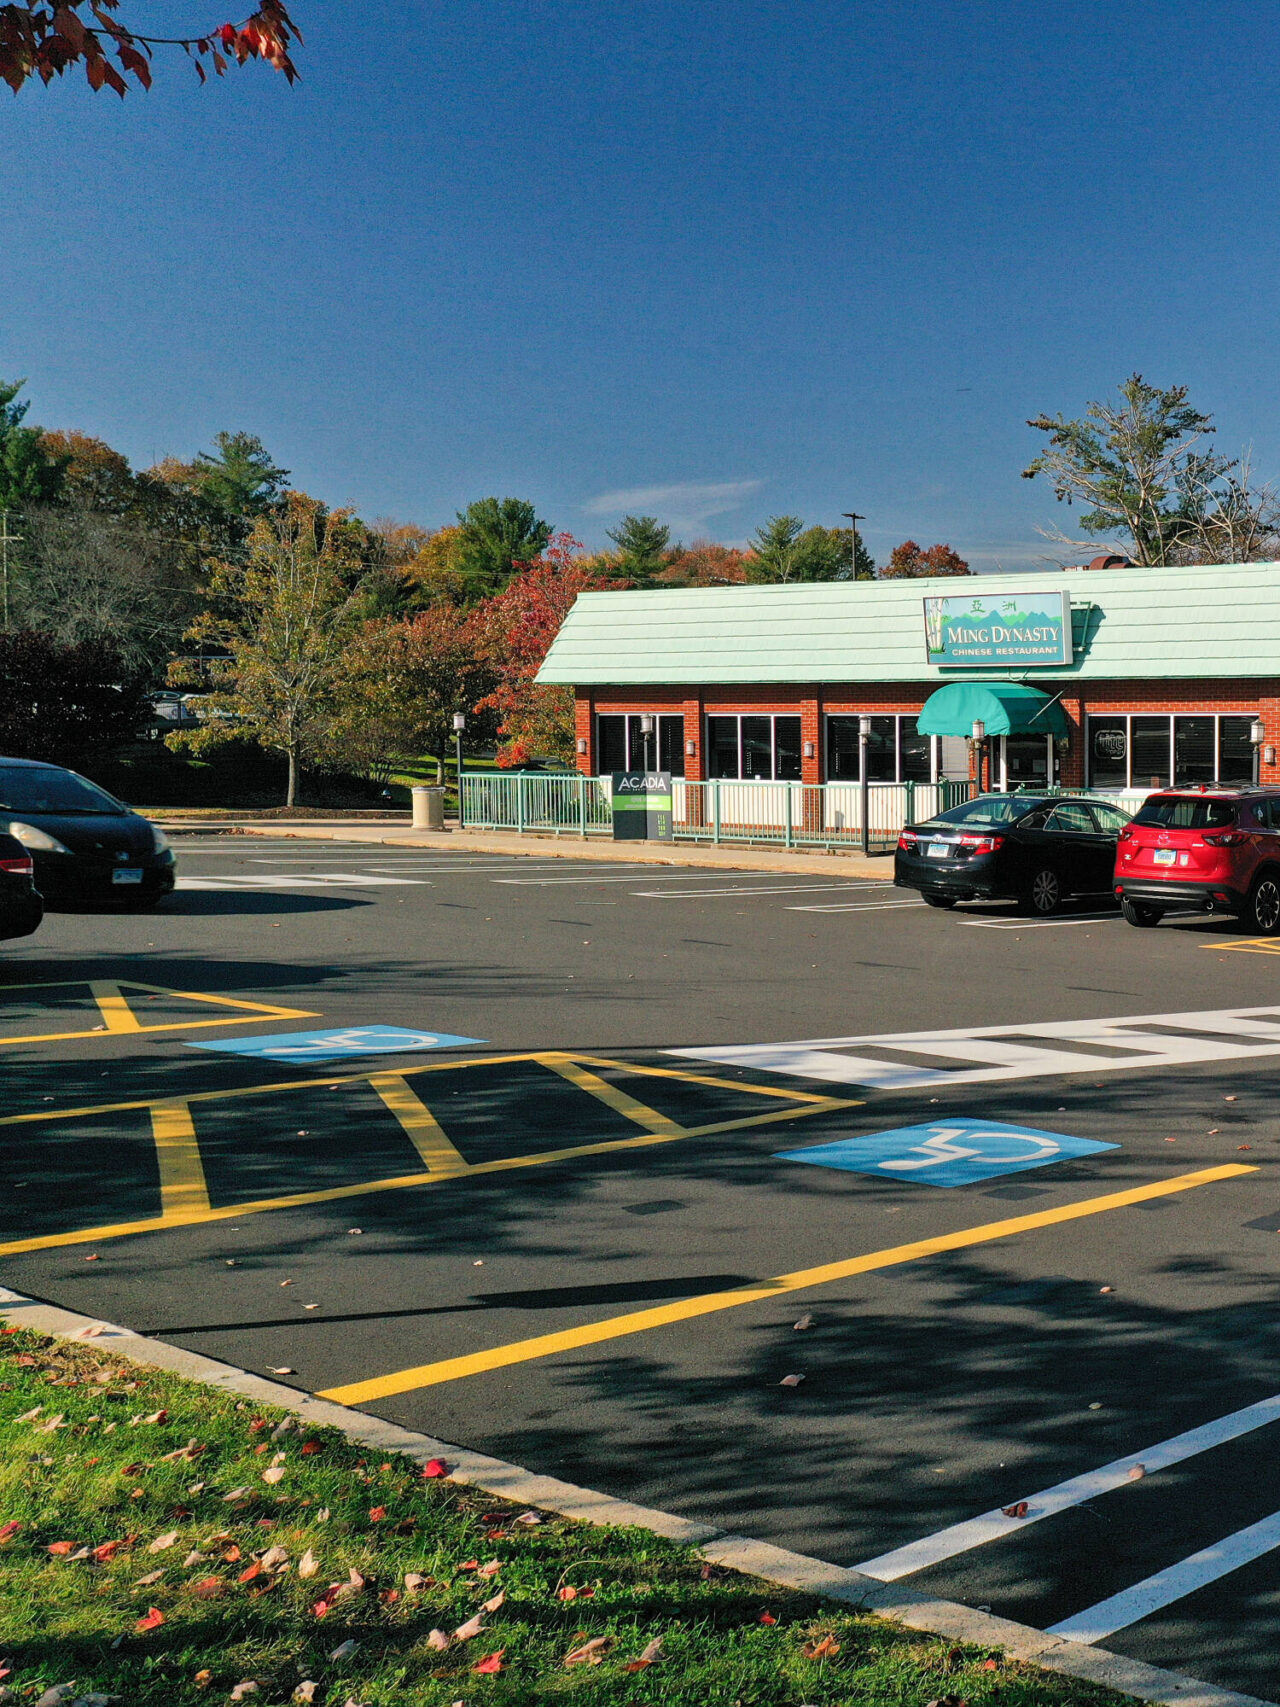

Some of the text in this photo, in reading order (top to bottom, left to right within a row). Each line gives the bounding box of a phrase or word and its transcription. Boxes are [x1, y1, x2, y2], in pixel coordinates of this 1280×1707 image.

[948, 626, 1059, 644] MING DYNASTY
[996, 647, 1059, 655] RESTAURANT
[618, 777, 667, 791] ACADIA
